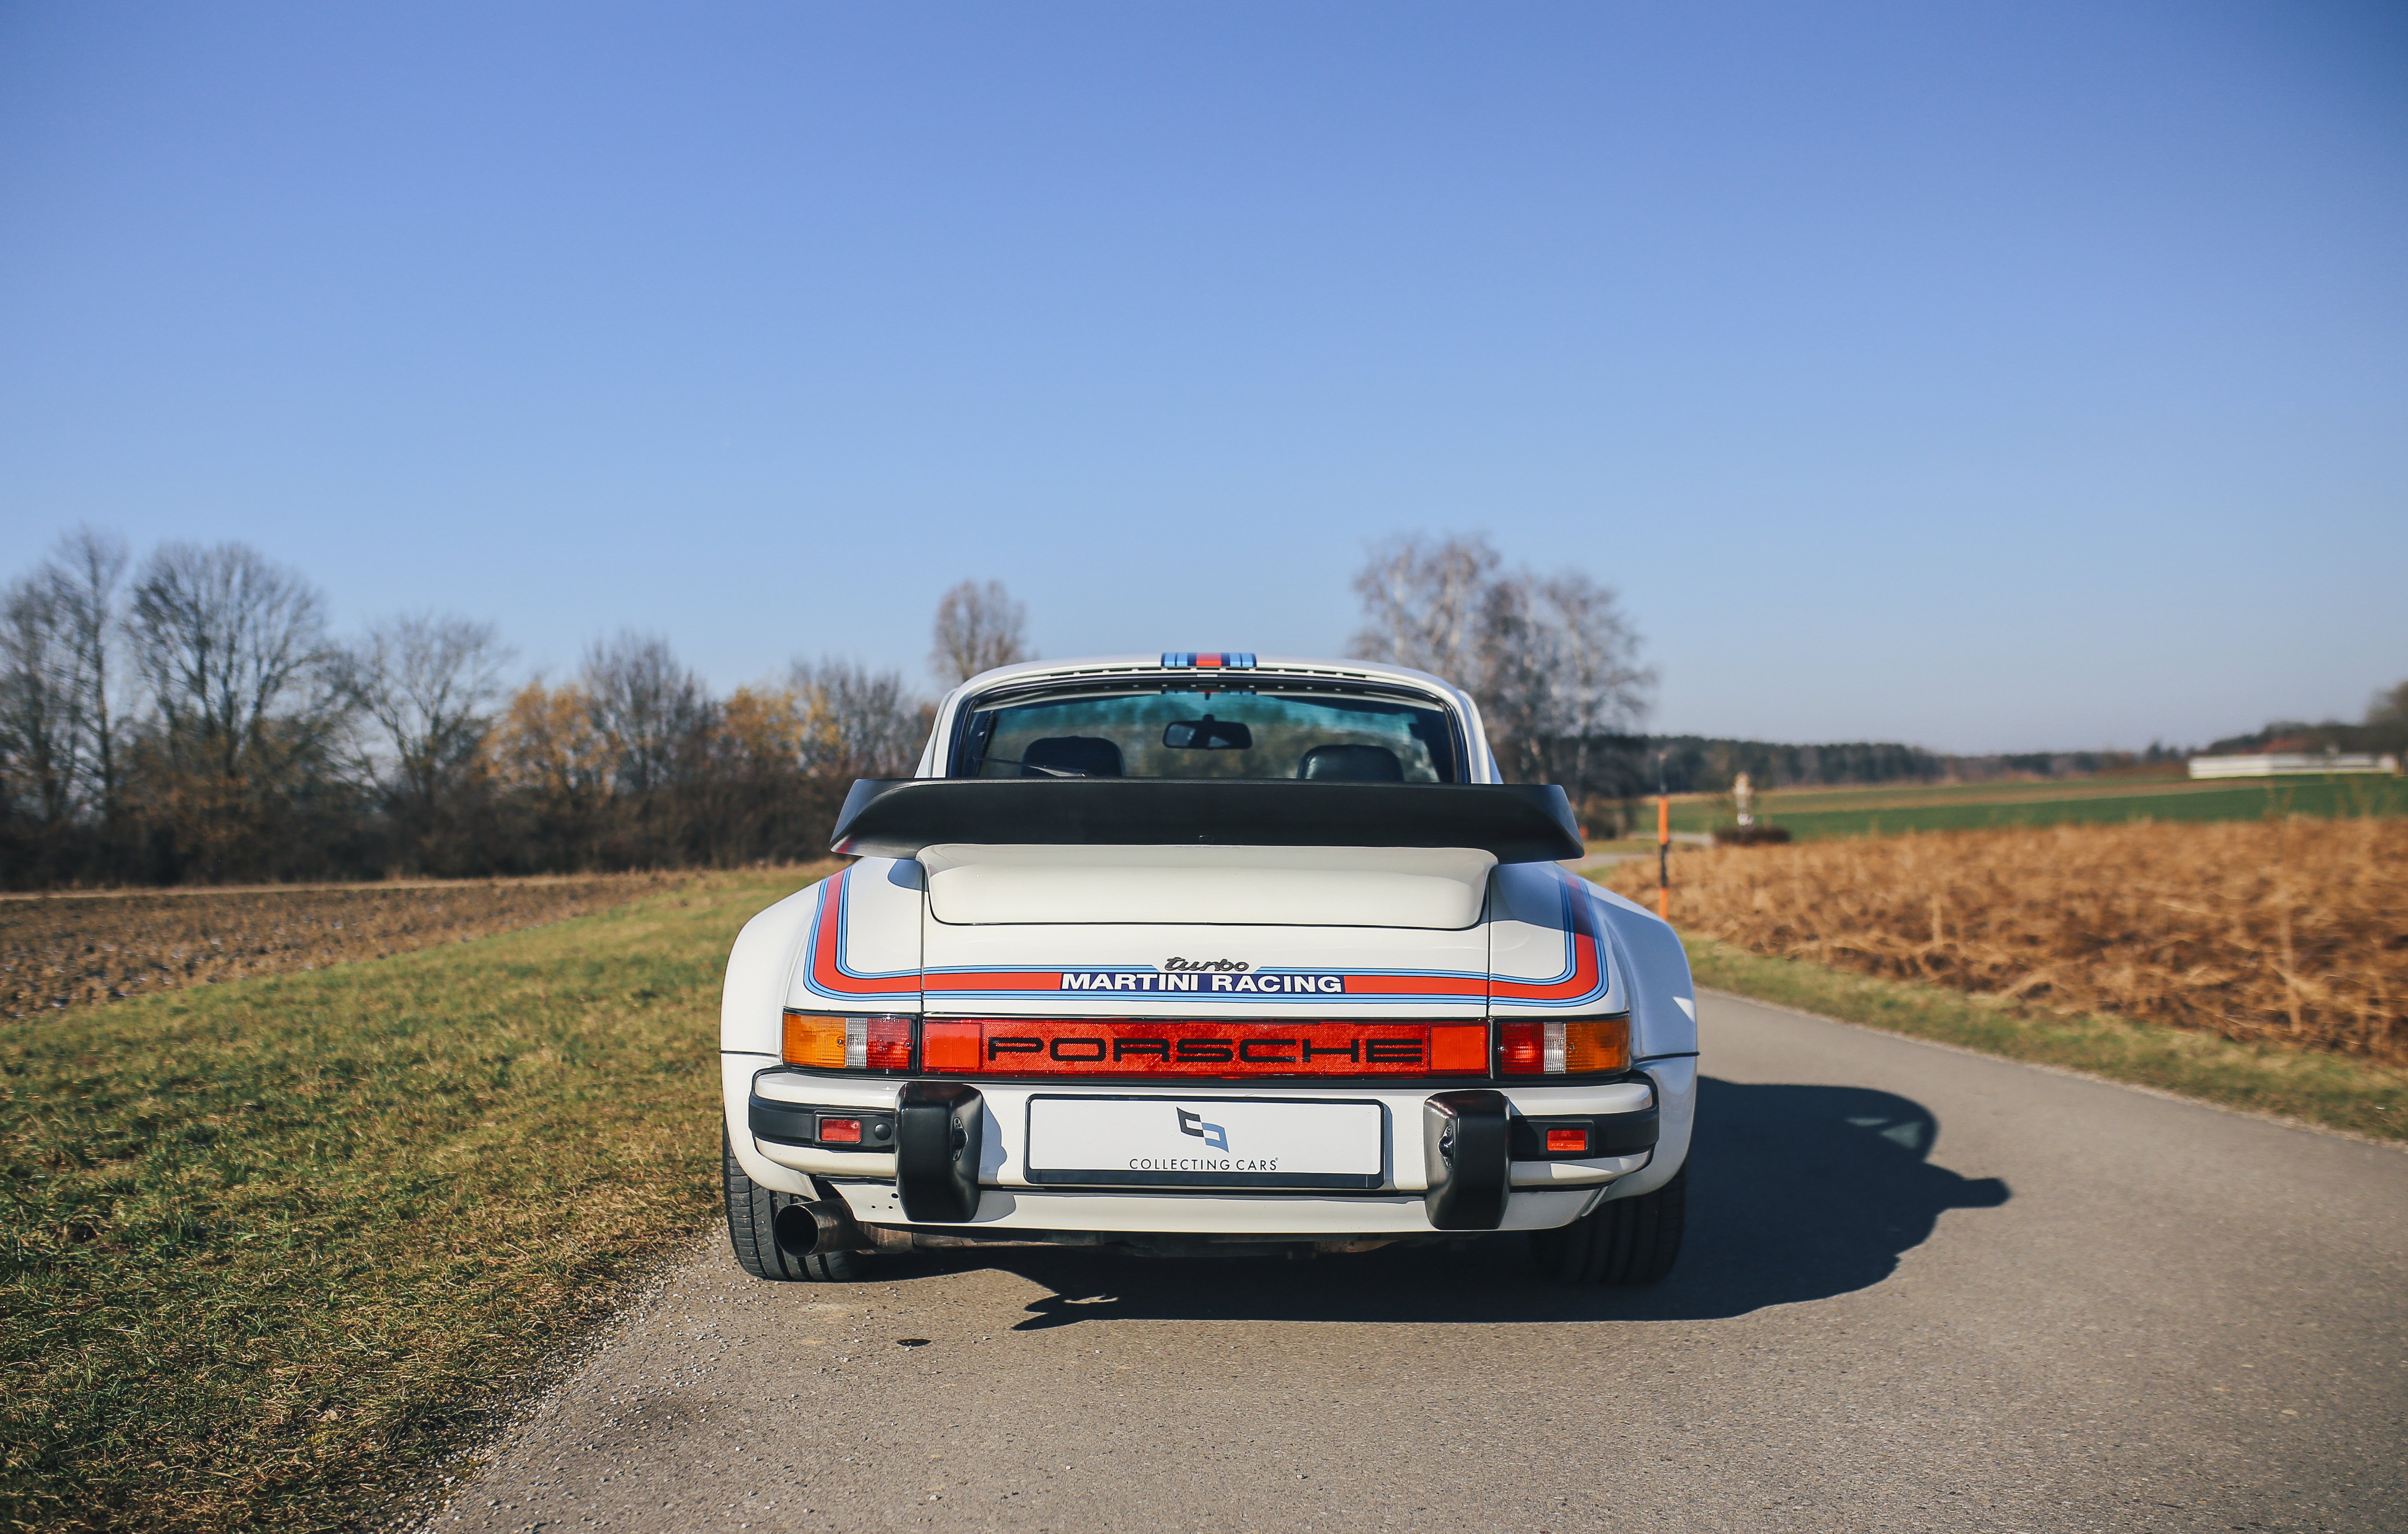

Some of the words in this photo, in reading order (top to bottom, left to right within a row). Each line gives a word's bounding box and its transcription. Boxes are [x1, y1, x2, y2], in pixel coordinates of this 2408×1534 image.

[1164, 956, 1249, 971] turbo
[1061, 973, 1199, 991] MARTINI
[1211, 974, 1342, 993] RACING
[988, 1037, 1423, 1063] PORSCHE
[1129, 1159, 1230, 1170] COLLECTING
